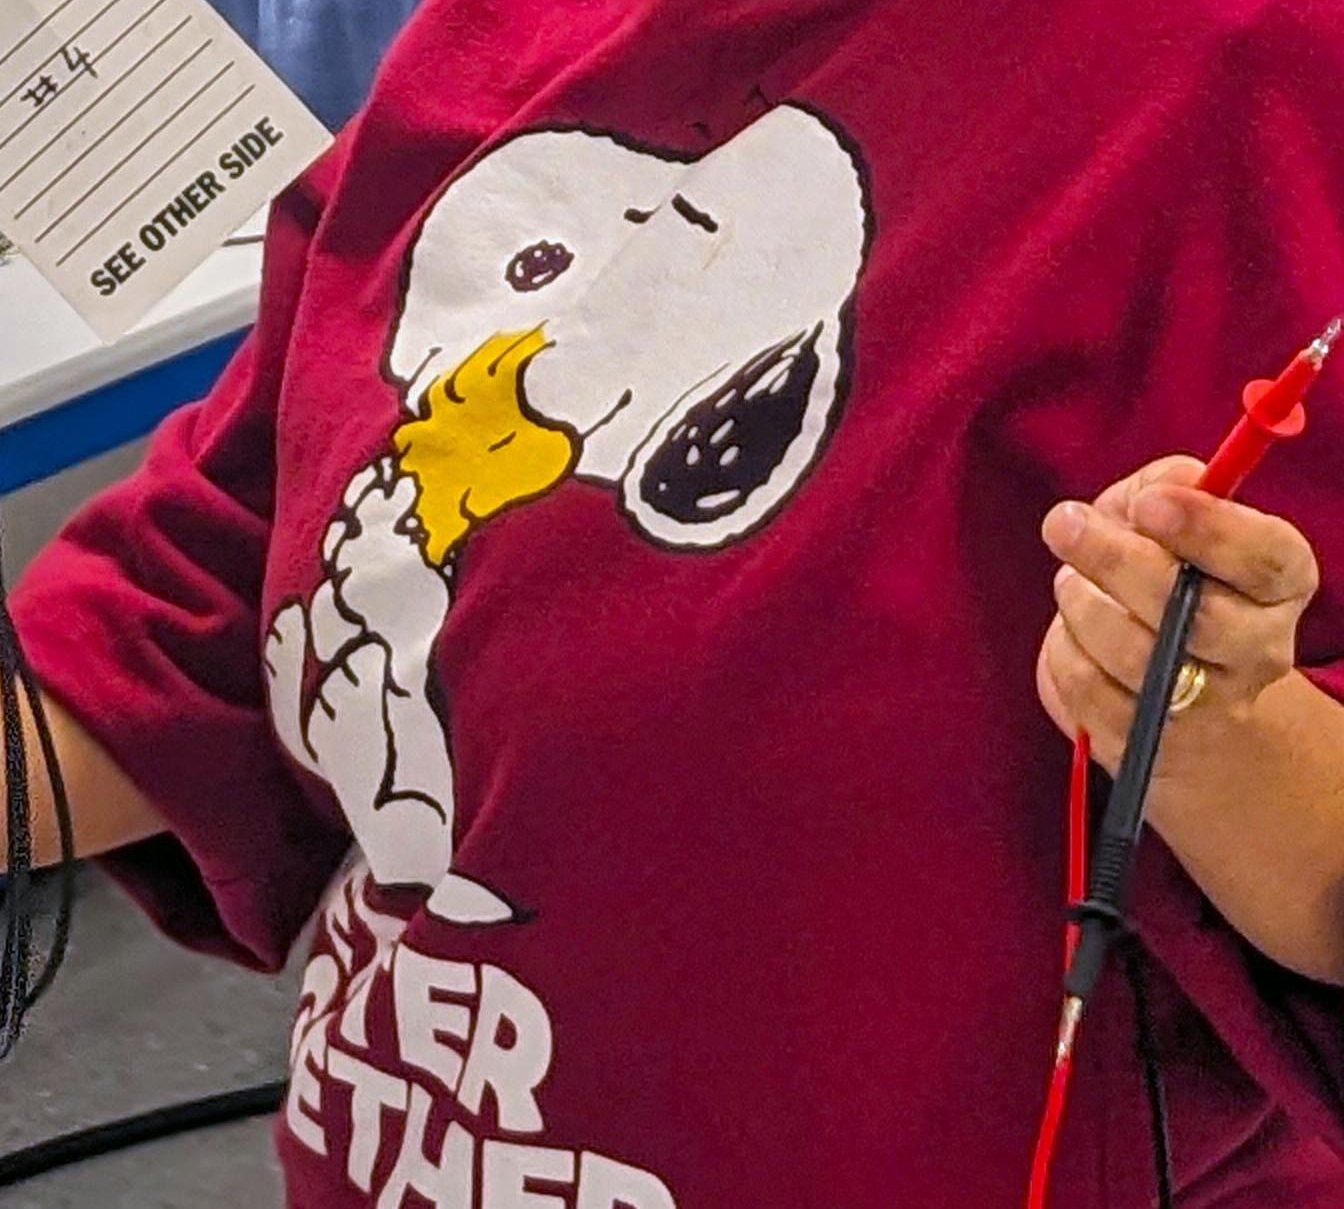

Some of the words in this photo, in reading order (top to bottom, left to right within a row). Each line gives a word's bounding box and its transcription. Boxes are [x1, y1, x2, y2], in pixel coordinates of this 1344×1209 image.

[59, 44, 99, 80] 4
[90, 240, 147, 297] SEE
[138, 170, 227, 253] OTHER
[218, 115, 285, 180] SIDE
